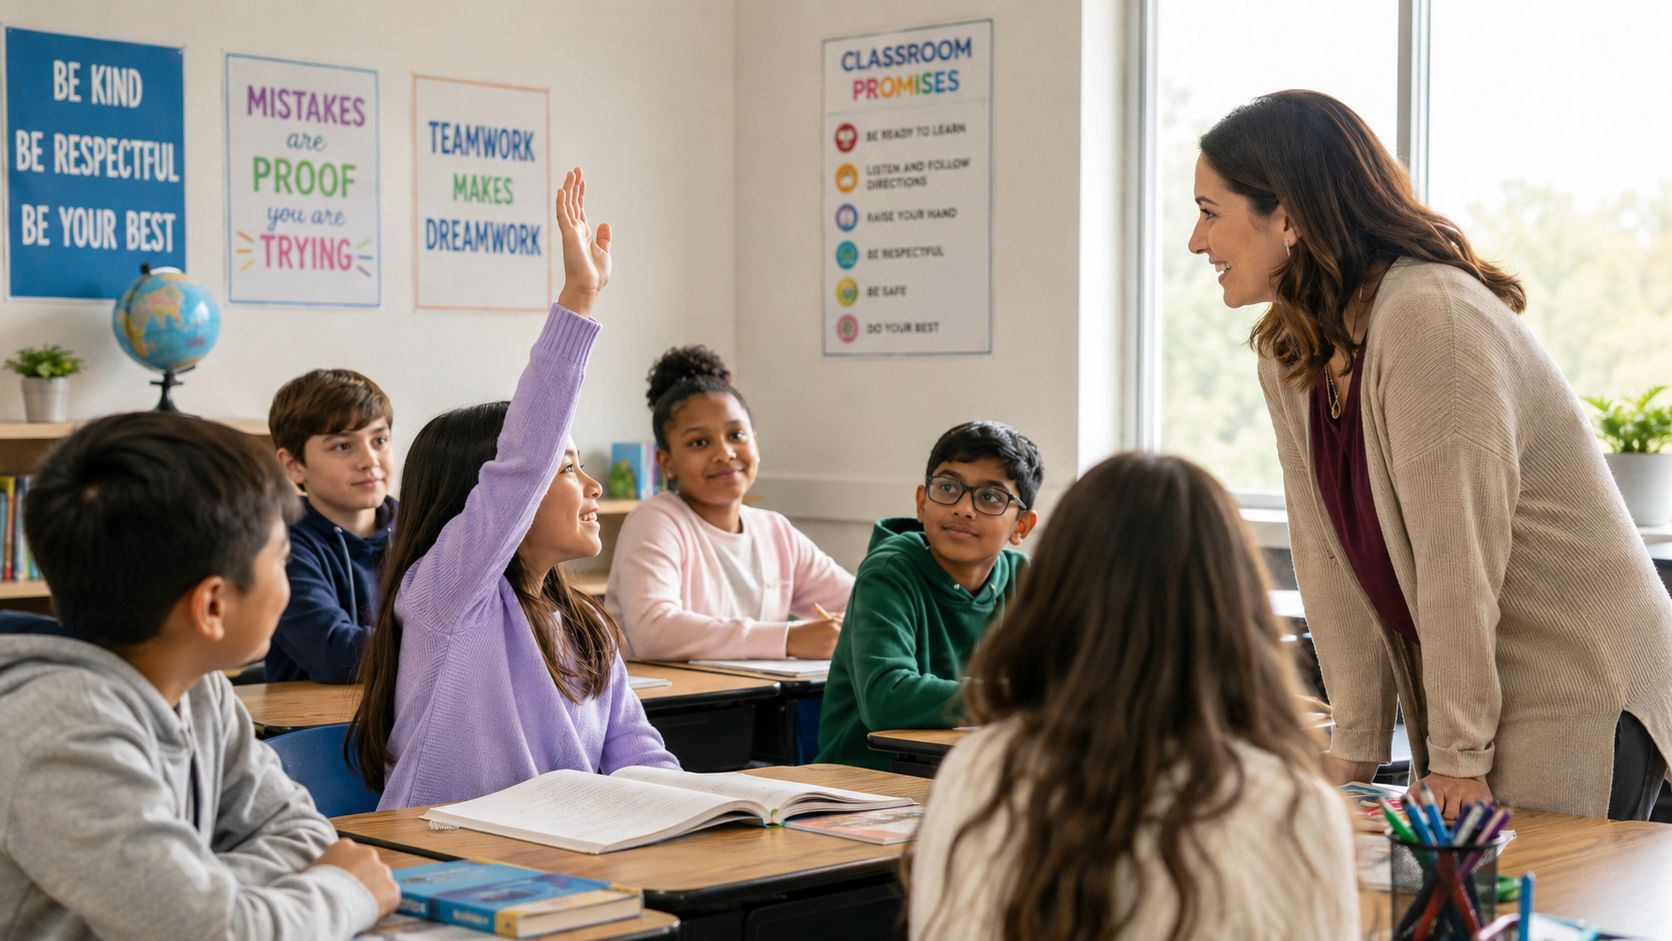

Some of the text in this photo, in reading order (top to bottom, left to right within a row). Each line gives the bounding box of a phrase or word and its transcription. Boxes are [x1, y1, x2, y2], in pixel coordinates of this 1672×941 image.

[841, 37, 972, 73] CLASSROOM
[53, 59, 143, 109] BE KIND
[852, 69, 960, 102] PROMISES
[247, 84, 365, 127] MISTAKES
[286, 131, 327, 152] are
[428, 120, 535, 162] TEAMWORK
[866, 122, 967, 142] BE READY TO LEARN
[16, 129, 179, 183] BE RESPECTFUL
[866, 157, 971, 176] LISTEN AND FOLLOW
[252, 156, 357, 198] PROOF
[453, 173, 514, 206] MAKES
[866, 175, 928, 190] DIRECTIONS
[21, 203, 176, 253] BE YOUR BEST
[267, 207, 346, 232] you are
[866, 206, 958, 223] RAISE YOUR HAND
[260, 234, 353, 272] TRYING
[426, 218, 542, 257] DREAMWORK
[866, 245, 944, 259] BE RESPECTFUL
[867, 284, 907, 297] BE SAFE
[866, 320, 940, 334] DO YOUR BEST
